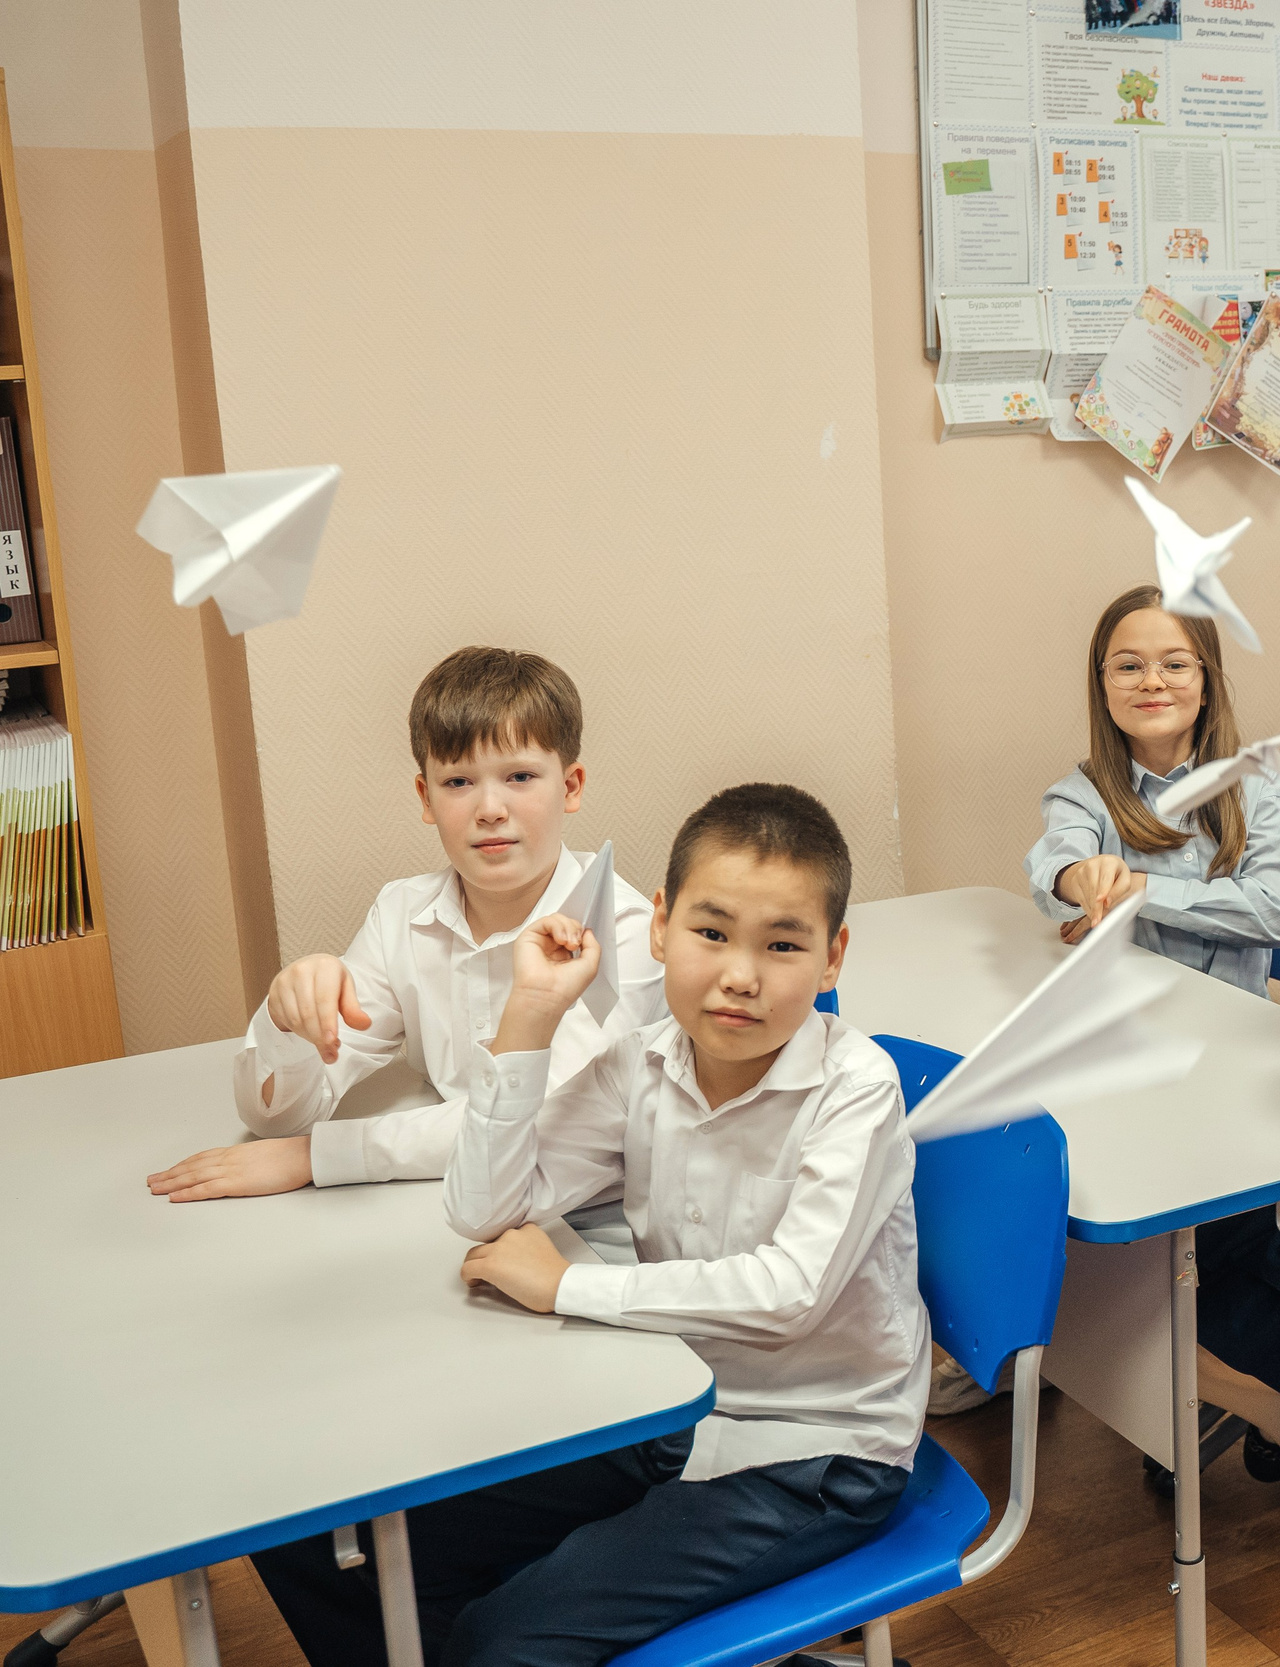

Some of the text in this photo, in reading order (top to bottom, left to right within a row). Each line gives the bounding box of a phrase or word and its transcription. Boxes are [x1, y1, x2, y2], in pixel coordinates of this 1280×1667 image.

[1064, 32, 1139, 45] Твоя безопасность
[1201, 73, 1218, 82] Наш
[947, 132, 1030, 144] Правила поведения
[1049, 136, 1095, 146] Расписание
[977, 147, 1017, 156] перемене
[968, 300, 1022, 310] Будь здоров!
[1066, 297, 1132, 309] Правила дружбы
[1158, 309, 1210, 352] ГРАМОТА
[2, 534, 20, 590] ЯЗЫК
